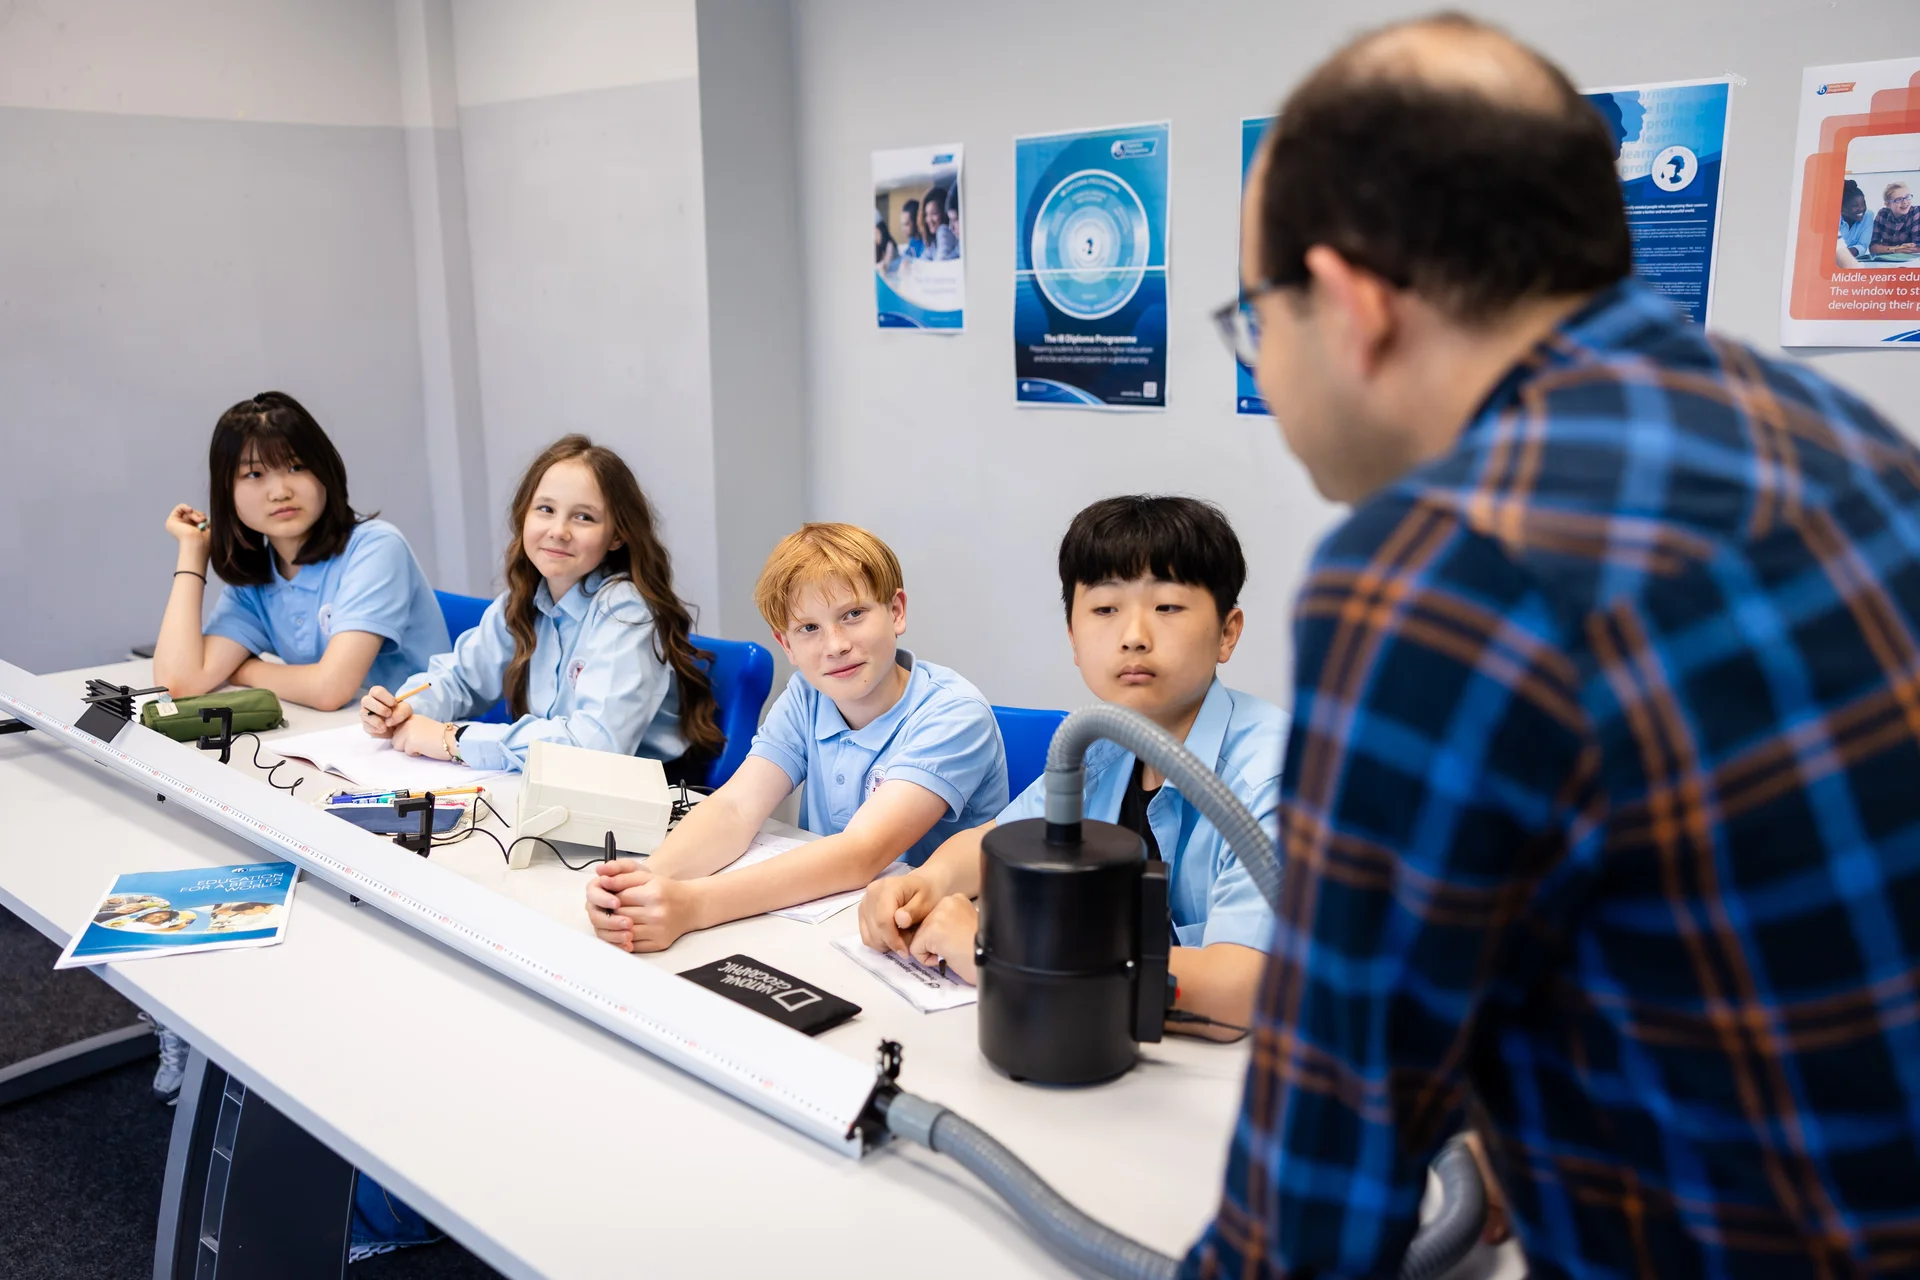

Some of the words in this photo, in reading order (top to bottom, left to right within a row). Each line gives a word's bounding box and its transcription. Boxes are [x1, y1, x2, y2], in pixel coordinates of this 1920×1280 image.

[1831, 273, 1867, 282] Middle
[1869, 274, 1896, 284] years
[1899, 272, 1920, 282] edu
[1830, 286, 1849, 296] The
[1852, 286, 1894, 296] window
[1896, 287, 1908, 296] to
[1828, 300, 1886, 312] developing
[1889, 300, 1914, 310] their
[1044, 333, 1056, 344] The
[1065, 334, 1094, 345] Diploma
[1095, 334, 1138, 345] Programme
[197, 872, 284, 886] EDUCATION
[229, 878, 282, 887] BETTER
[224, 882, 281, 892] WORLD
[718, 961, 792, 990] GEOGRAPHIC
[720, 974, 778, 995] NATIONAL
